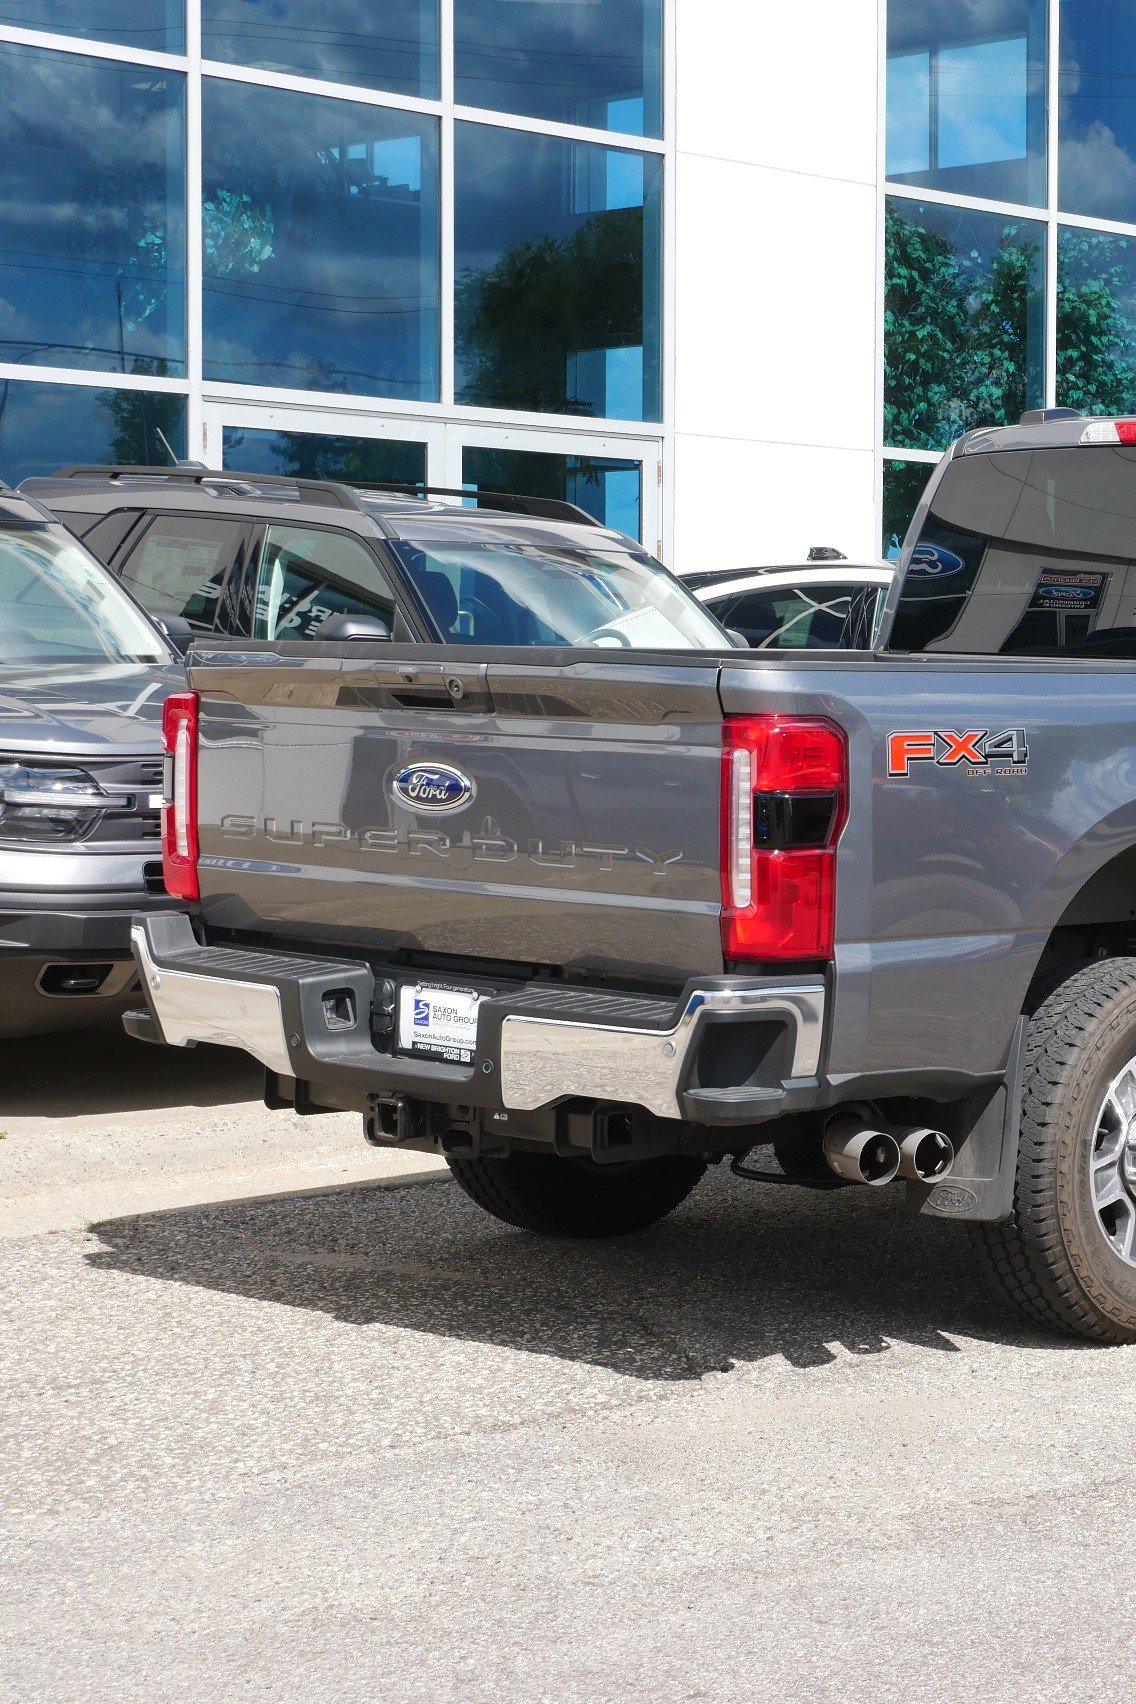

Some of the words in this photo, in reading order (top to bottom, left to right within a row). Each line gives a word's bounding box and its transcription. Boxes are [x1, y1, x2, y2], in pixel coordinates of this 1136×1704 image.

[886, 728, 1029, 778] FX4
[967, 768, 991, 776] OFF
[995, 767, 1028, 776] ROAD
[408, 771, 450, 799] Ford
[220, 813, 450, 858] SUPER
[471, 835, 685, 875] DUTY
[432, 1006, 457, 1015] SAXON
[432, 1013, 451, 1022] AUTO
[417, 1042, 431, 1051] NEW
[430, 1045, 460, 1054] BRIGHTON
[443, 1052, 460, 1061] FORD
